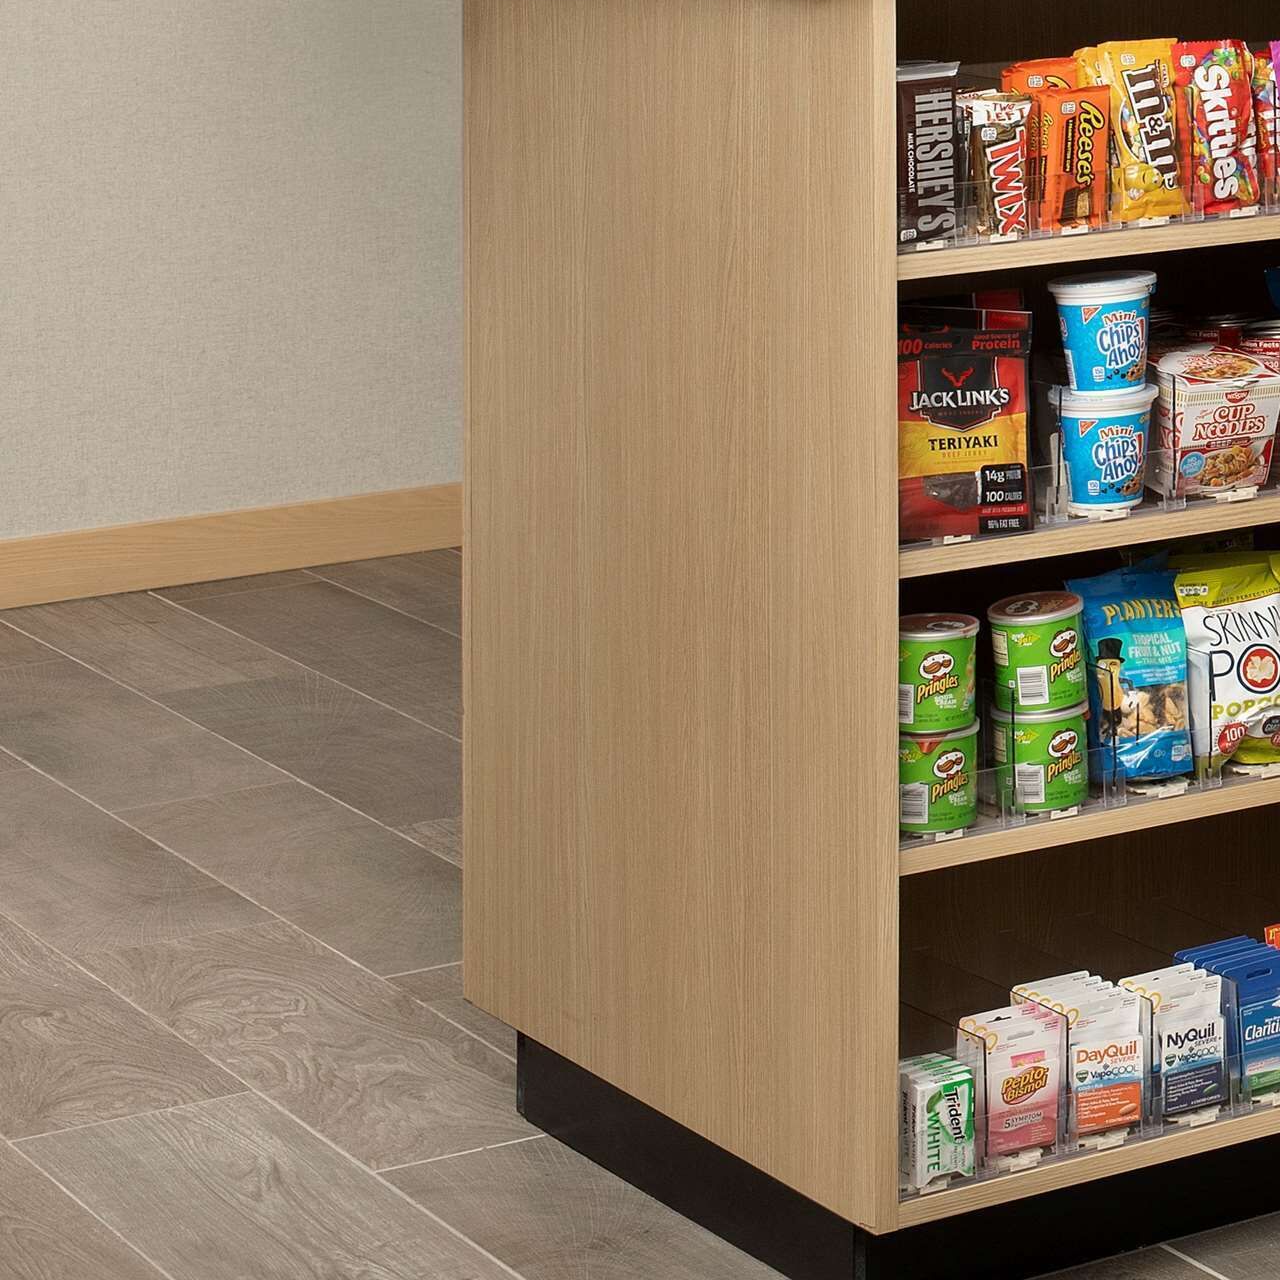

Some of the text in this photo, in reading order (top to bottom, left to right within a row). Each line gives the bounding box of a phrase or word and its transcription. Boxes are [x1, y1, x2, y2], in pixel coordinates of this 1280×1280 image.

[992, 103, 1016, 112] TWO
[1075, 101, 1105, 187] Reese's
[1194, 64, 1239, 199] Skittles
[908, 151, 916, 193] CHOCOLATE
[914, 91, 956, 241] HERSHEY'S
[986, 125, 1027, 234] TWIX
[1103, 310, 1137, 325] Mini
[971, 338, 1021, 351] Protein
[1097, 321, 1141, 354] Chips
[909, 387, 1010, 411] JACK LINK'S
[1213, 404, 1256, 423] CUP
[1099, 425, 1134, 441] Mini
[1193, 416, 1267, 442] NOODLES
[928, 434, 999, 451] TERIYAKI
[1093, 436, 1137, 467] Chips
[985, 469, 1005, 483] 14g
[985, 490, 1005, 503] 100
[1132, 632, 1173, 647] TROPICAL
[1160, 642, 1182, 655] NUT
[917, 675, 959, 704] Pringles
[931, 770, 969, 804] Pringles
[1166, 1022, 1216, 1049] NyQuil
[1076, 1040, 1138, 1065] DayQuil
[1006, 1077, 1049, 1101] Bismol
[944, 1086, 966, 1142] Trident
[927, 1111, 941, 1173] WHITE
